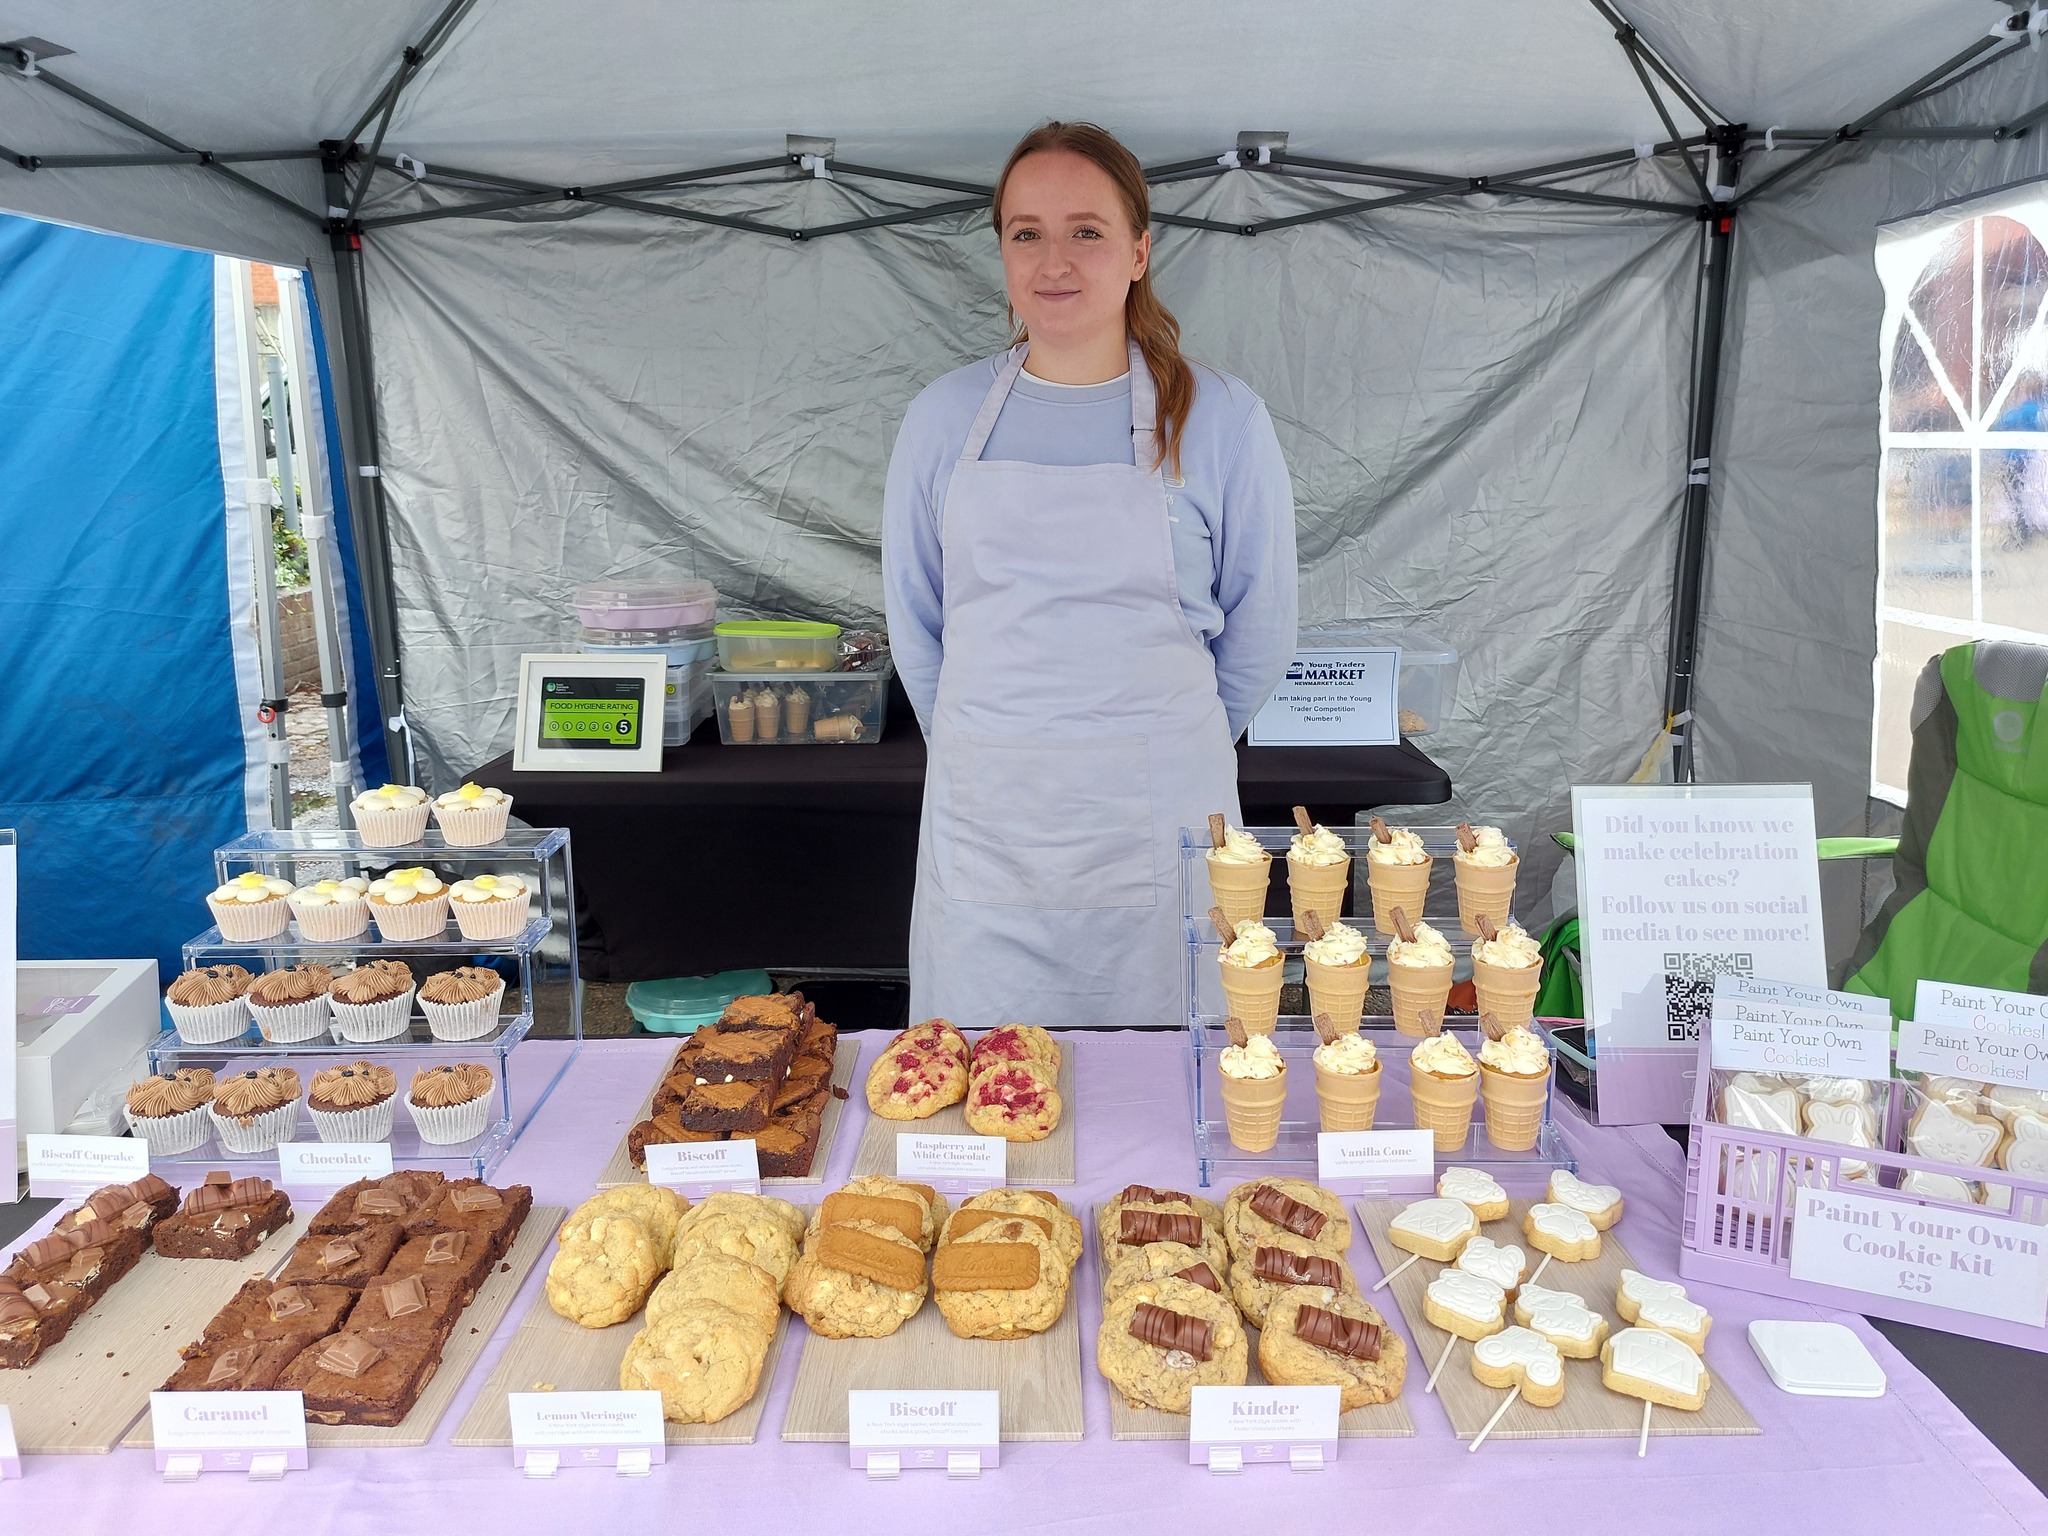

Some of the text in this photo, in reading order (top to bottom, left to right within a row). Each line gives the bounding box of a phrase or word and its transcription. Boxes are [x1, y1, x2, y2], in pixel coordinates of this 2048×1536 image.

[1304, 669, 1366, 679] MARKET
[1349, 695, 1372, 703] Young
[1604, 815, 1795, 839] Did you know we
[1604, 842, 1799, 860] make celebration
[1664, 868, 1740, 887] cakes?
[1601, 895, 1809, 914] Follow us on social
[1601, 923, 1810, 941] media to see more!
[1738, 980, 1779, 995] Paint
[1783, 986, 1822, 1003] Your
[1826, 993, 1863, 1011] Own
[1940, 989, 1986, 1010] Paint
[1990, 996, 2035, 1016] Your
[1736, 1005, 1778, 1023] Paint
[1781, 1010, 1822, 1026] Your
[1973, 1014, 2045, 1039] Cookies!
[1733, 1024, 1863, 1050] Paint Your Own
[1923, 1029, 2048, 1061] Paint Your Ow
[1764, 1047, 1830, 1068] Cookies!
[1956, 1055, 2029, 1081] Cookies!
[676, 1148, 728, 1162] Biscoff
[915, 1141, 986, 1152] Raspberry and
[1340, 1146, 1412, 1158] Vanilla Cone
[41, 1149, 134, 1163] Biscoff Cupcake
[299, 1152, 372, 1165] Chocolate
[912, 1151, 991, 1162] White Chocolate
[1808, 1198, 2040, 1256] Paint Your Own
[1842, 1232, 1997, 1277] Cookie Kit
[1897, 1270, 1933, 1294] £5
[183, 1405, 268, 1421] Caramel
[536, 1410, 637, 1422] Lemon Meringue
[889, 1401, 957, 1417] Biscoff
[1232, 1400, 1300, 1416] Kinder
